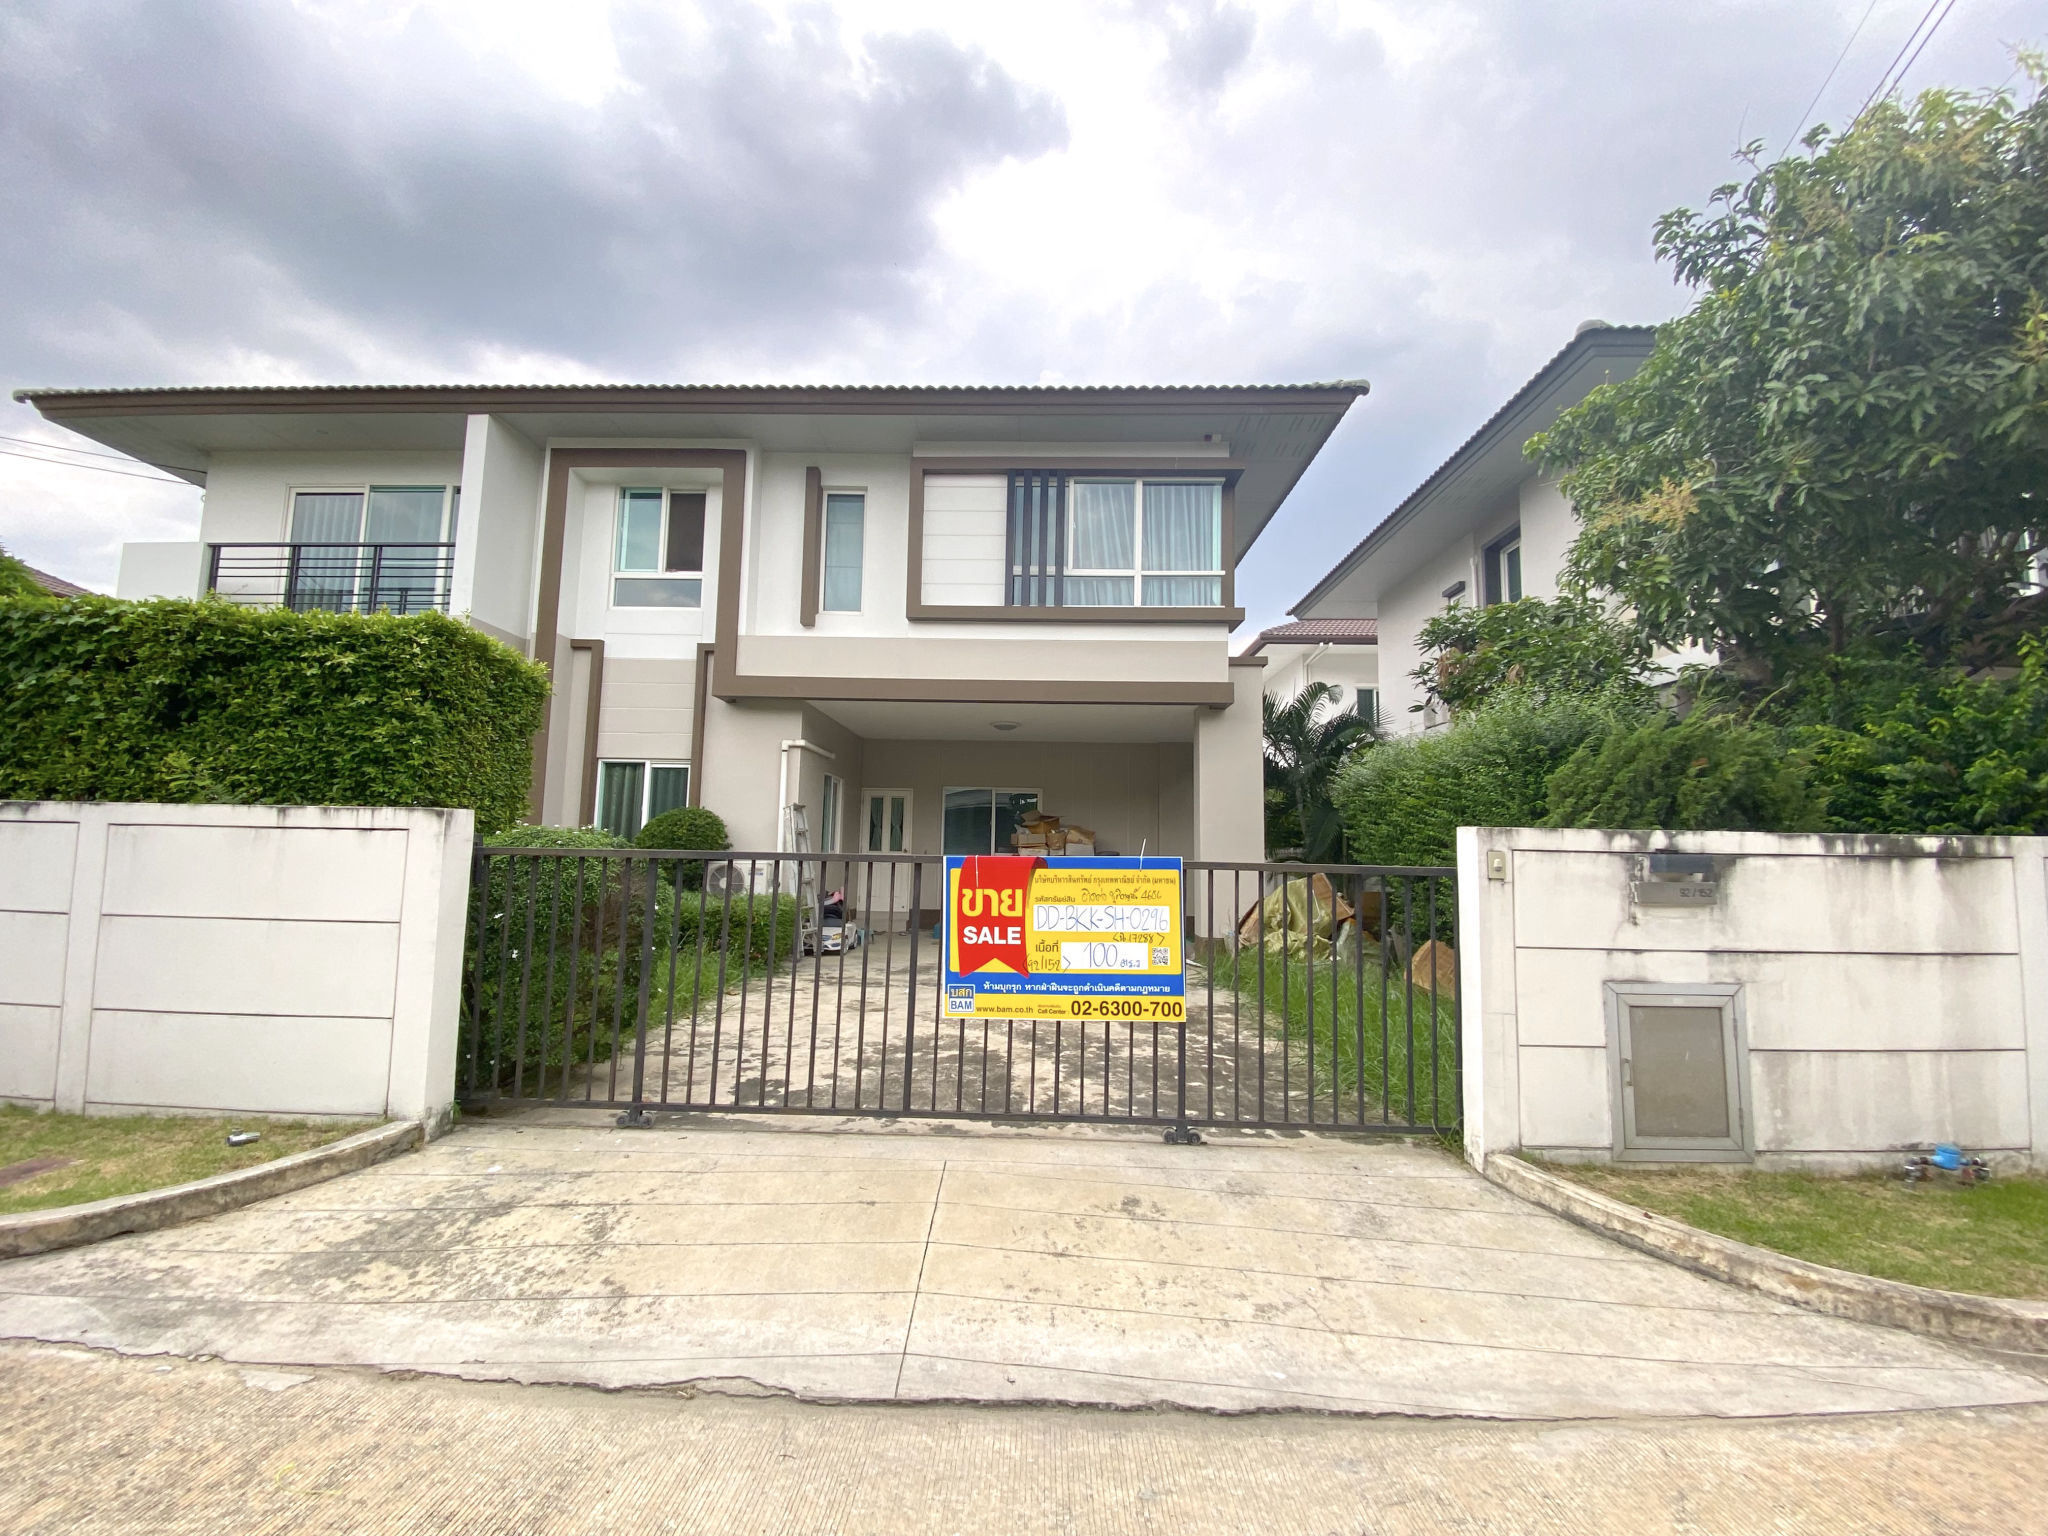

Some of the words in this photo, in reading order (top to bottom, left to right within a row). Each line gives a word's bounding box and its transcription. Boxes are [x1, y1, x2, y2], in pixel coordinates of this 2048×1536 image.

[961, 888, 1023, 917] ขาย
[963, 926, 1021, 945] SALE
[1035, 939, 1059, 953] เนื้อที่
[1083, 942, 1118, 968] 100
[951, 987, 973, 998] บสก
[983, 981, 1022, 993] ห้ามบุกรุก
[950, 1000, 972, 1011] BAM
[976, 1005, 1034, 1014] www.bam.co.th
[1071, 1000, 1182, 1017] 02-6300-700
